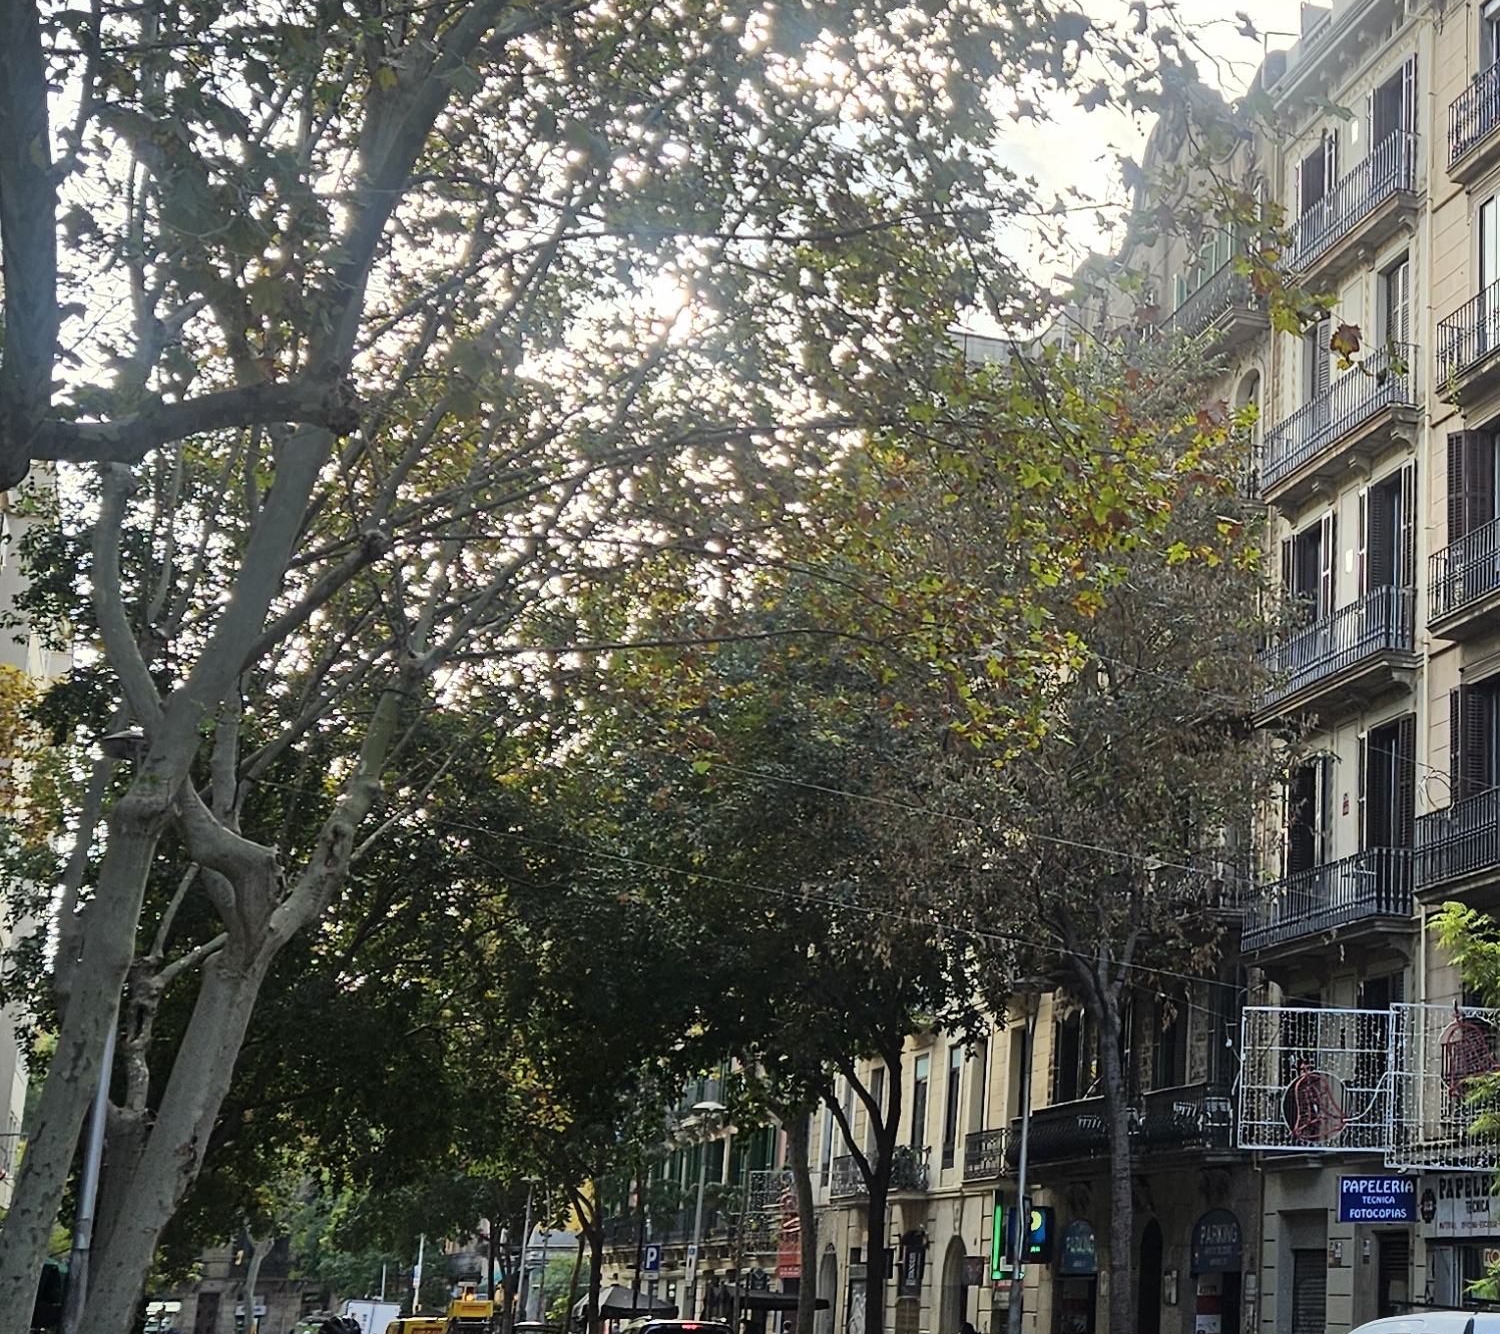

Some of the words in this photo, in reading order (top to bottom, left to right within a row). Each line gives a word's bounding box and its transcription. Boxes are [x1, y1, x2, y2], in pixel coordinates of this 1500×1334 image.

[1342, 1180, 1414, 1194] PAPELERIA
[1362, 1196, 1396, 1205] TECNICA
[1466, 1199, 1490, 1214] TECNICA
[1349, 1208, 1408, 1219] FOTOCOPIAS
[1200, 1223, 1238, 1245] PARKING
[646, 1247, 657, 1269] P
